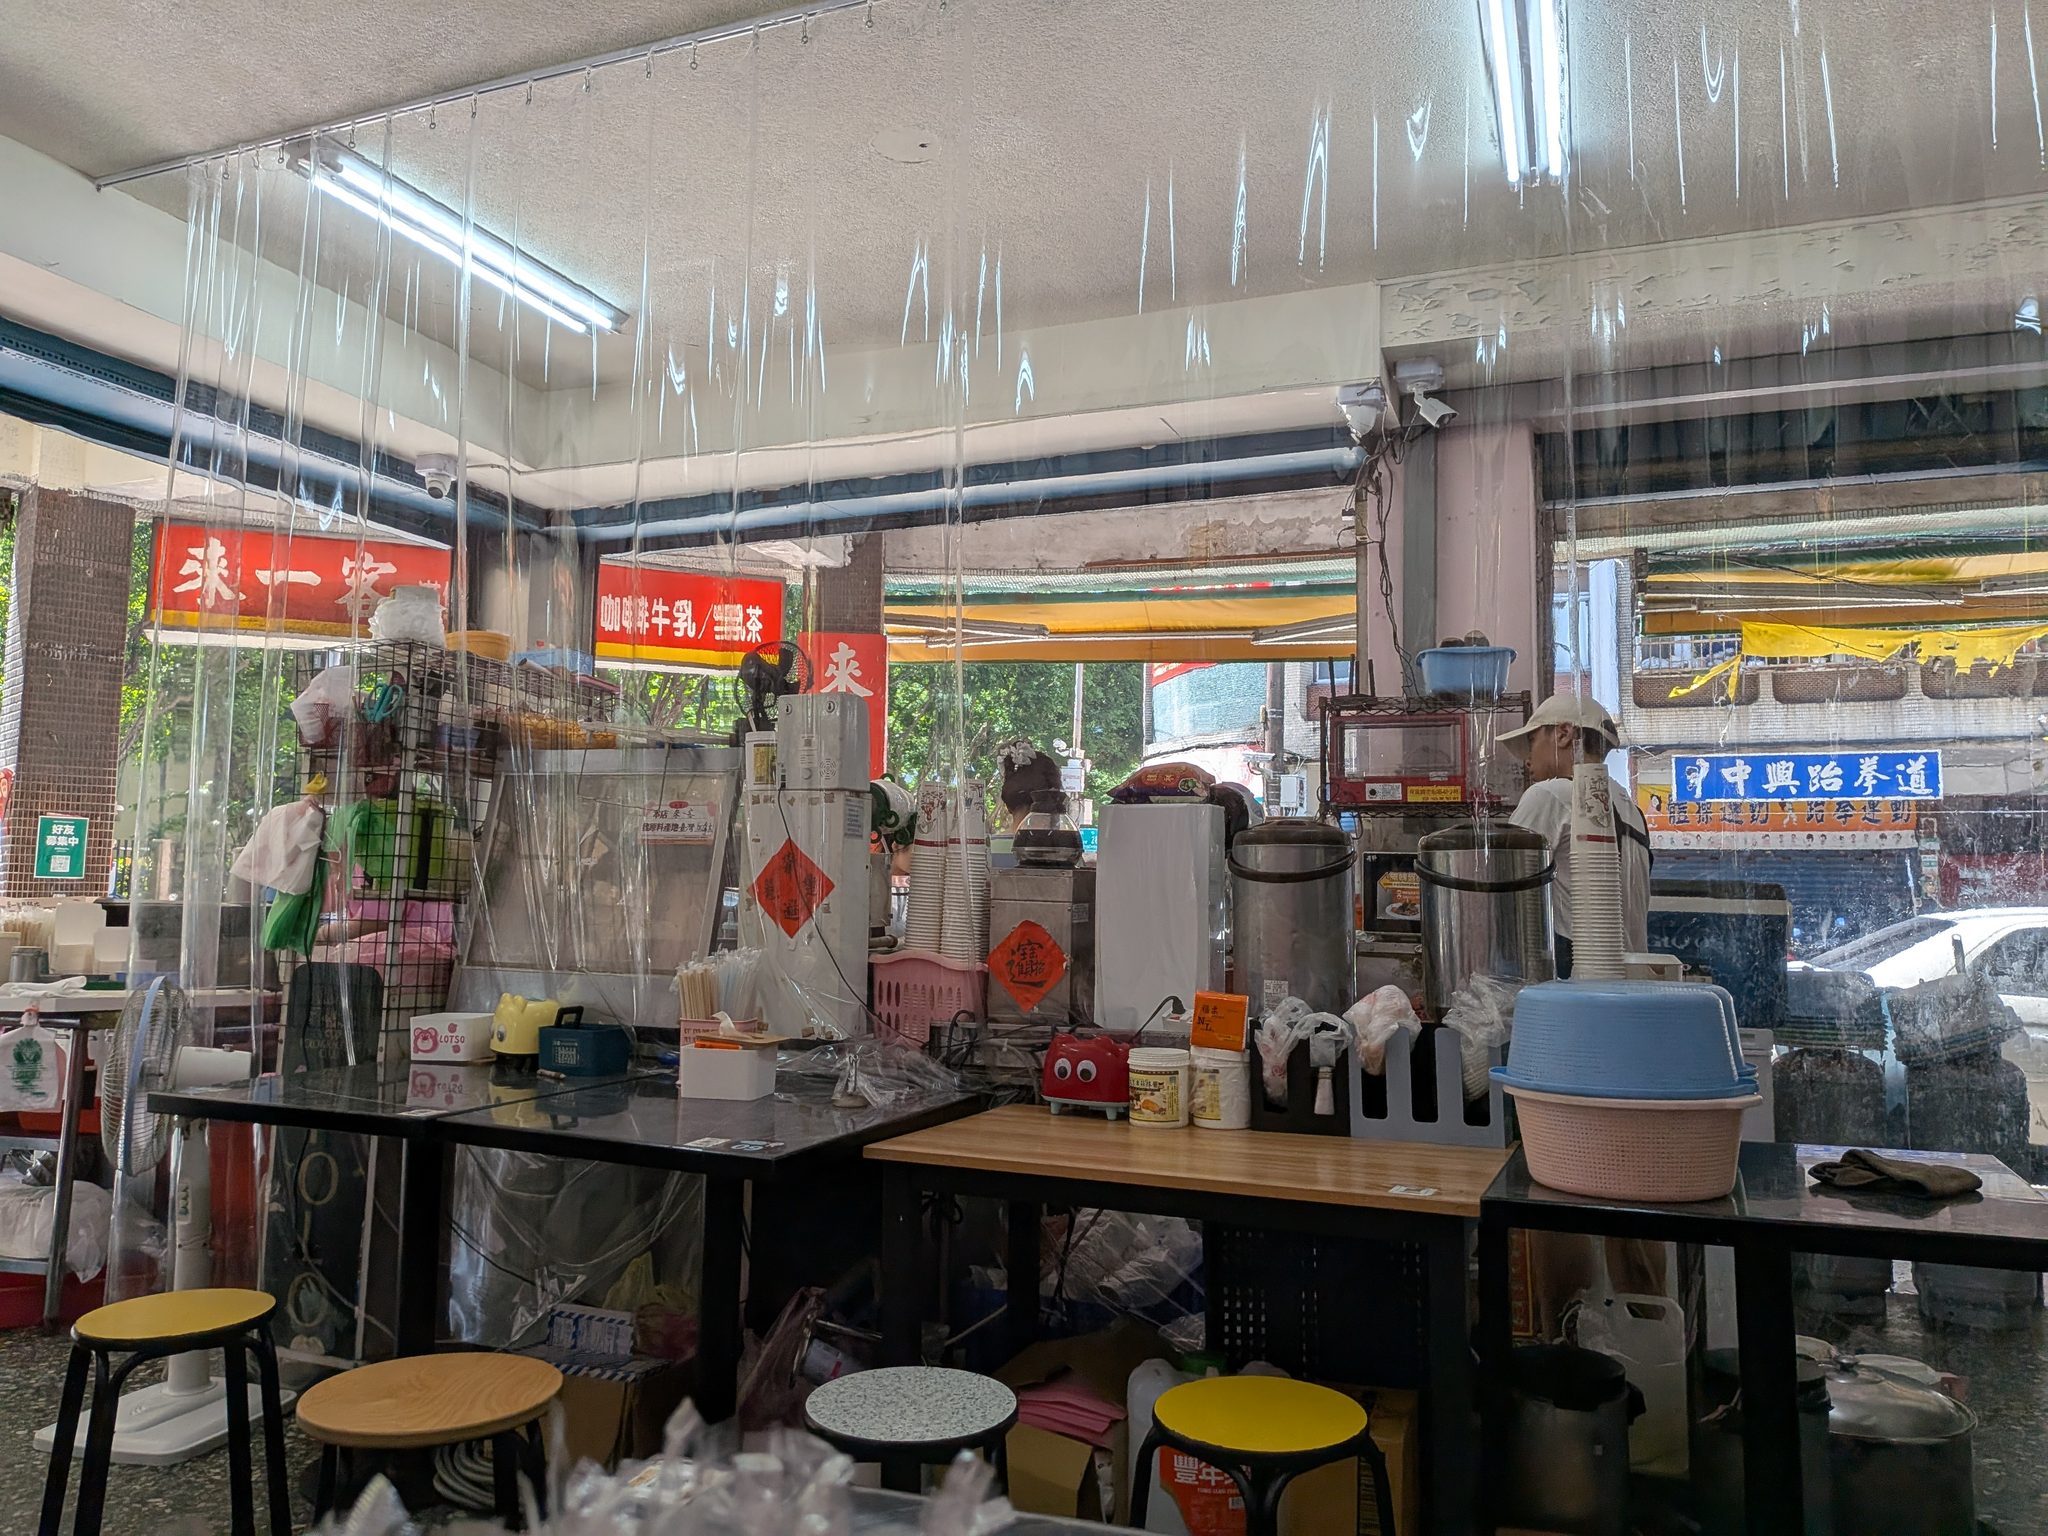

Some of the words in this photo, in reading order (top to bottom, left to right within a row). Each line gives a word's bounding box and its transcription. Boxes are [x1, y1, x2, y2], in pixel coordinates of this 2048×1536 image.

[1721, 754, 1934, 797] 中興跆拳道
[52, 824, 75, 835] 好友
[46, 835, 79, 846] 募集中
[439, 1034, 465, 1044] LOTSO
